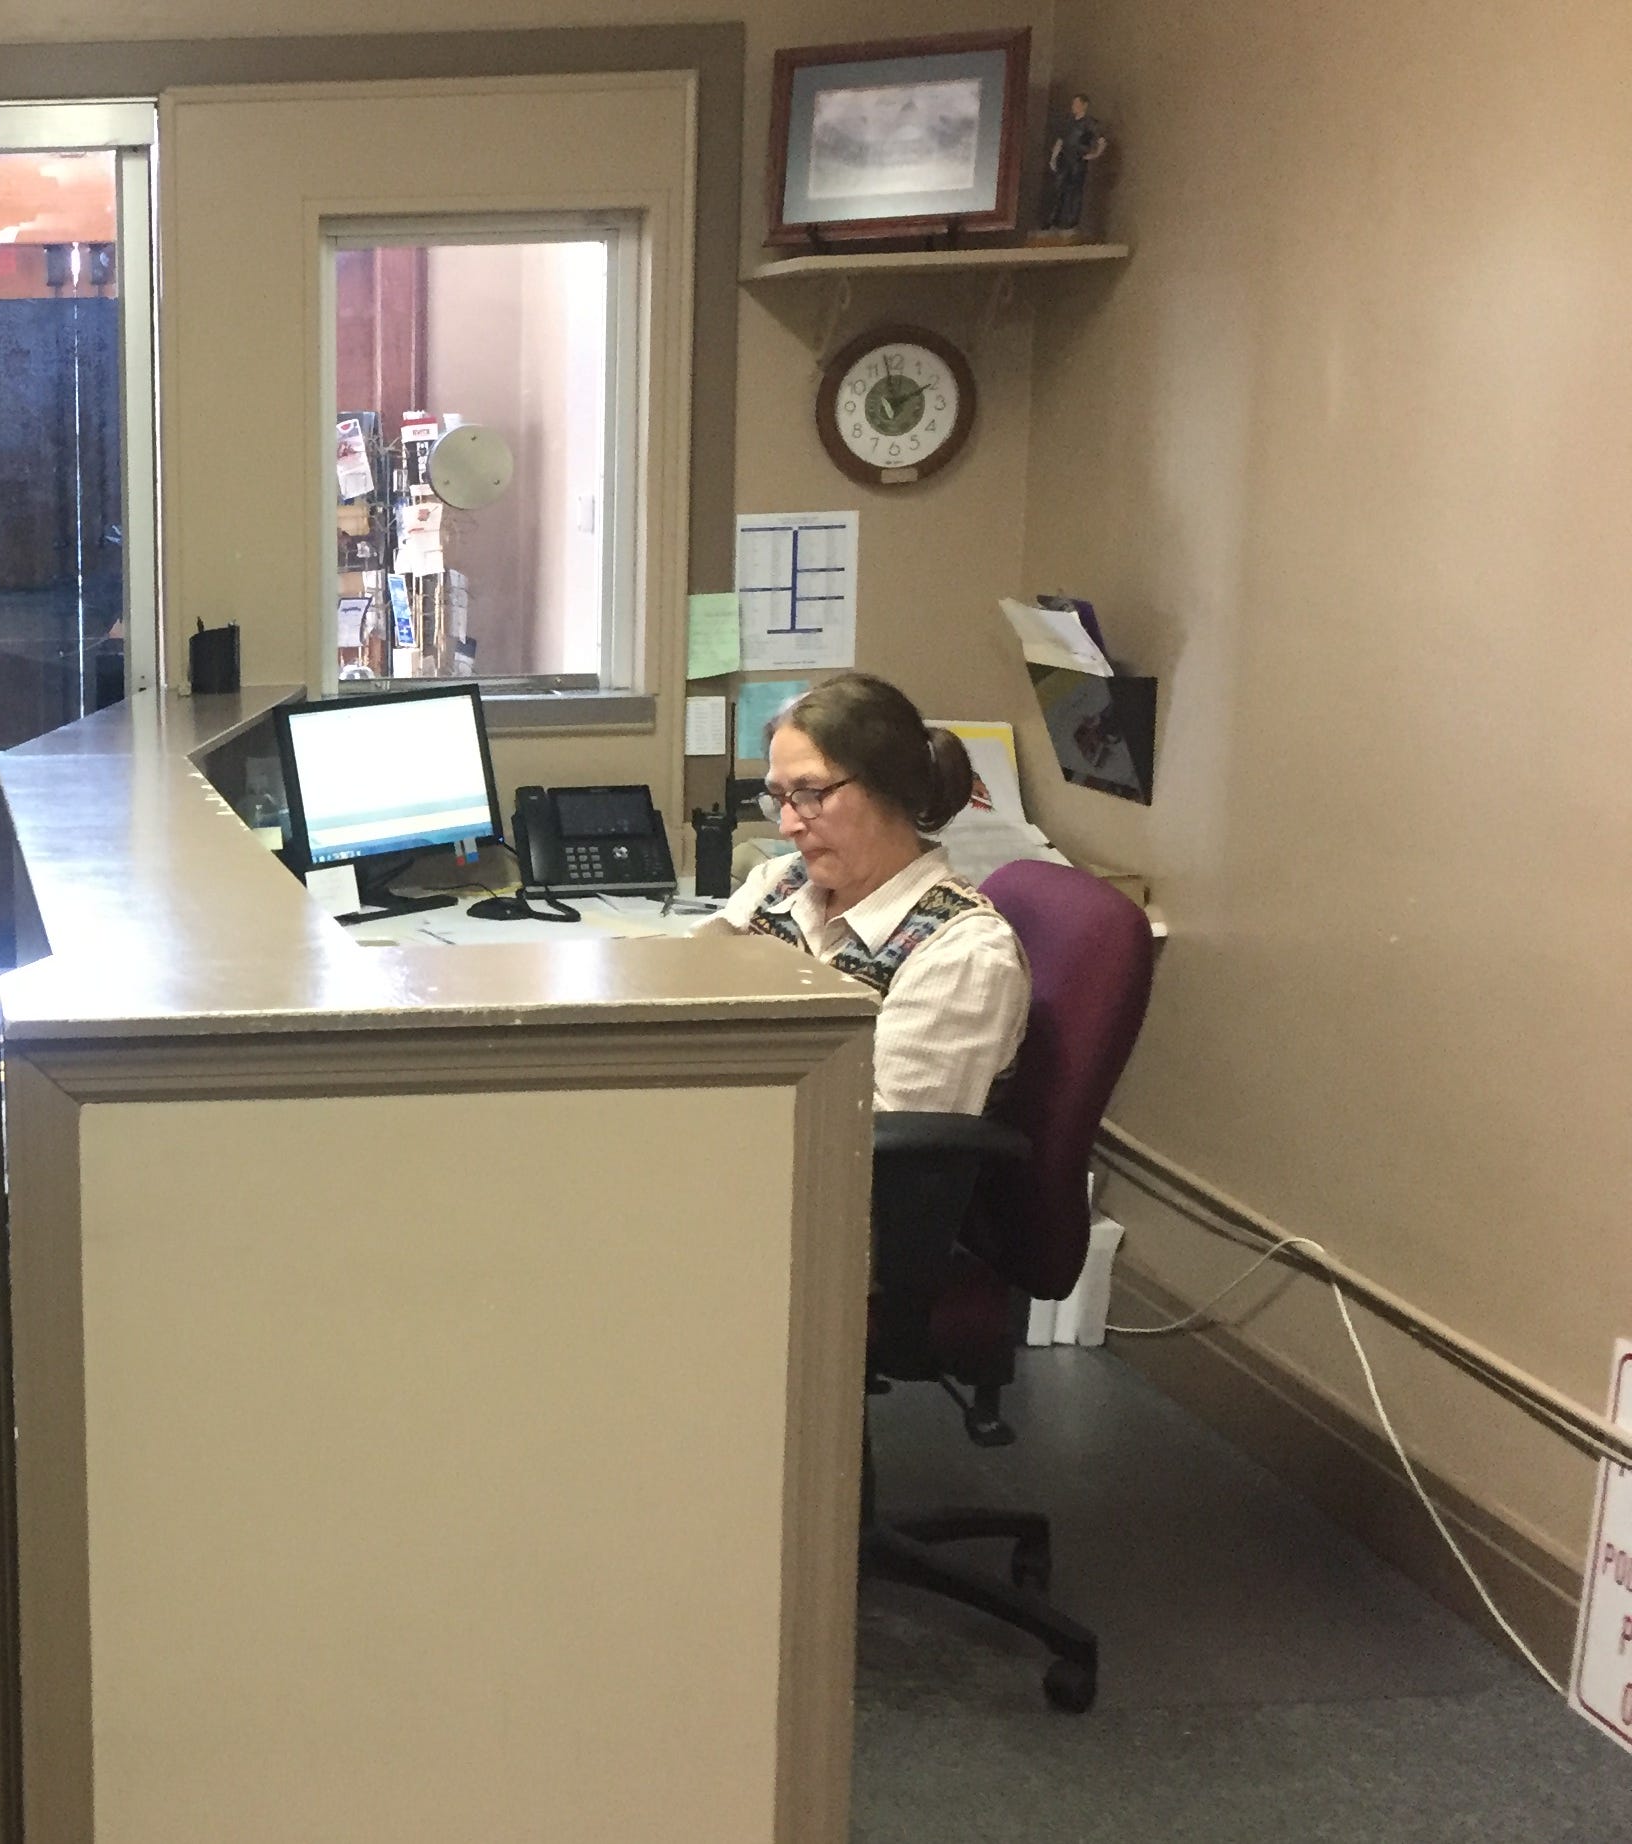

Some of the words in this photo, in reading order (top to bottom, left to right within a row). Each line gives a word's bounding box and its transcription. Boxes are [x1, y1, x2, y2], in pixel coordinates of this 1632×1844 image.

[868, 363, 879, 378] 11
[889, 354, 905, 371] 12
[915, 361, 922, 375] 1
[849, 379, 867, 396] 10
[929, 374, 940, 391] 2
[934, 394, 946, 411] 3
[852, 423, 862, 439] 8
[924, 418, 937, 432] 4
[870, 437, 880, 453] 7
[888, 441, 901, 457] 6
[909, 434, 921, 451] 5
